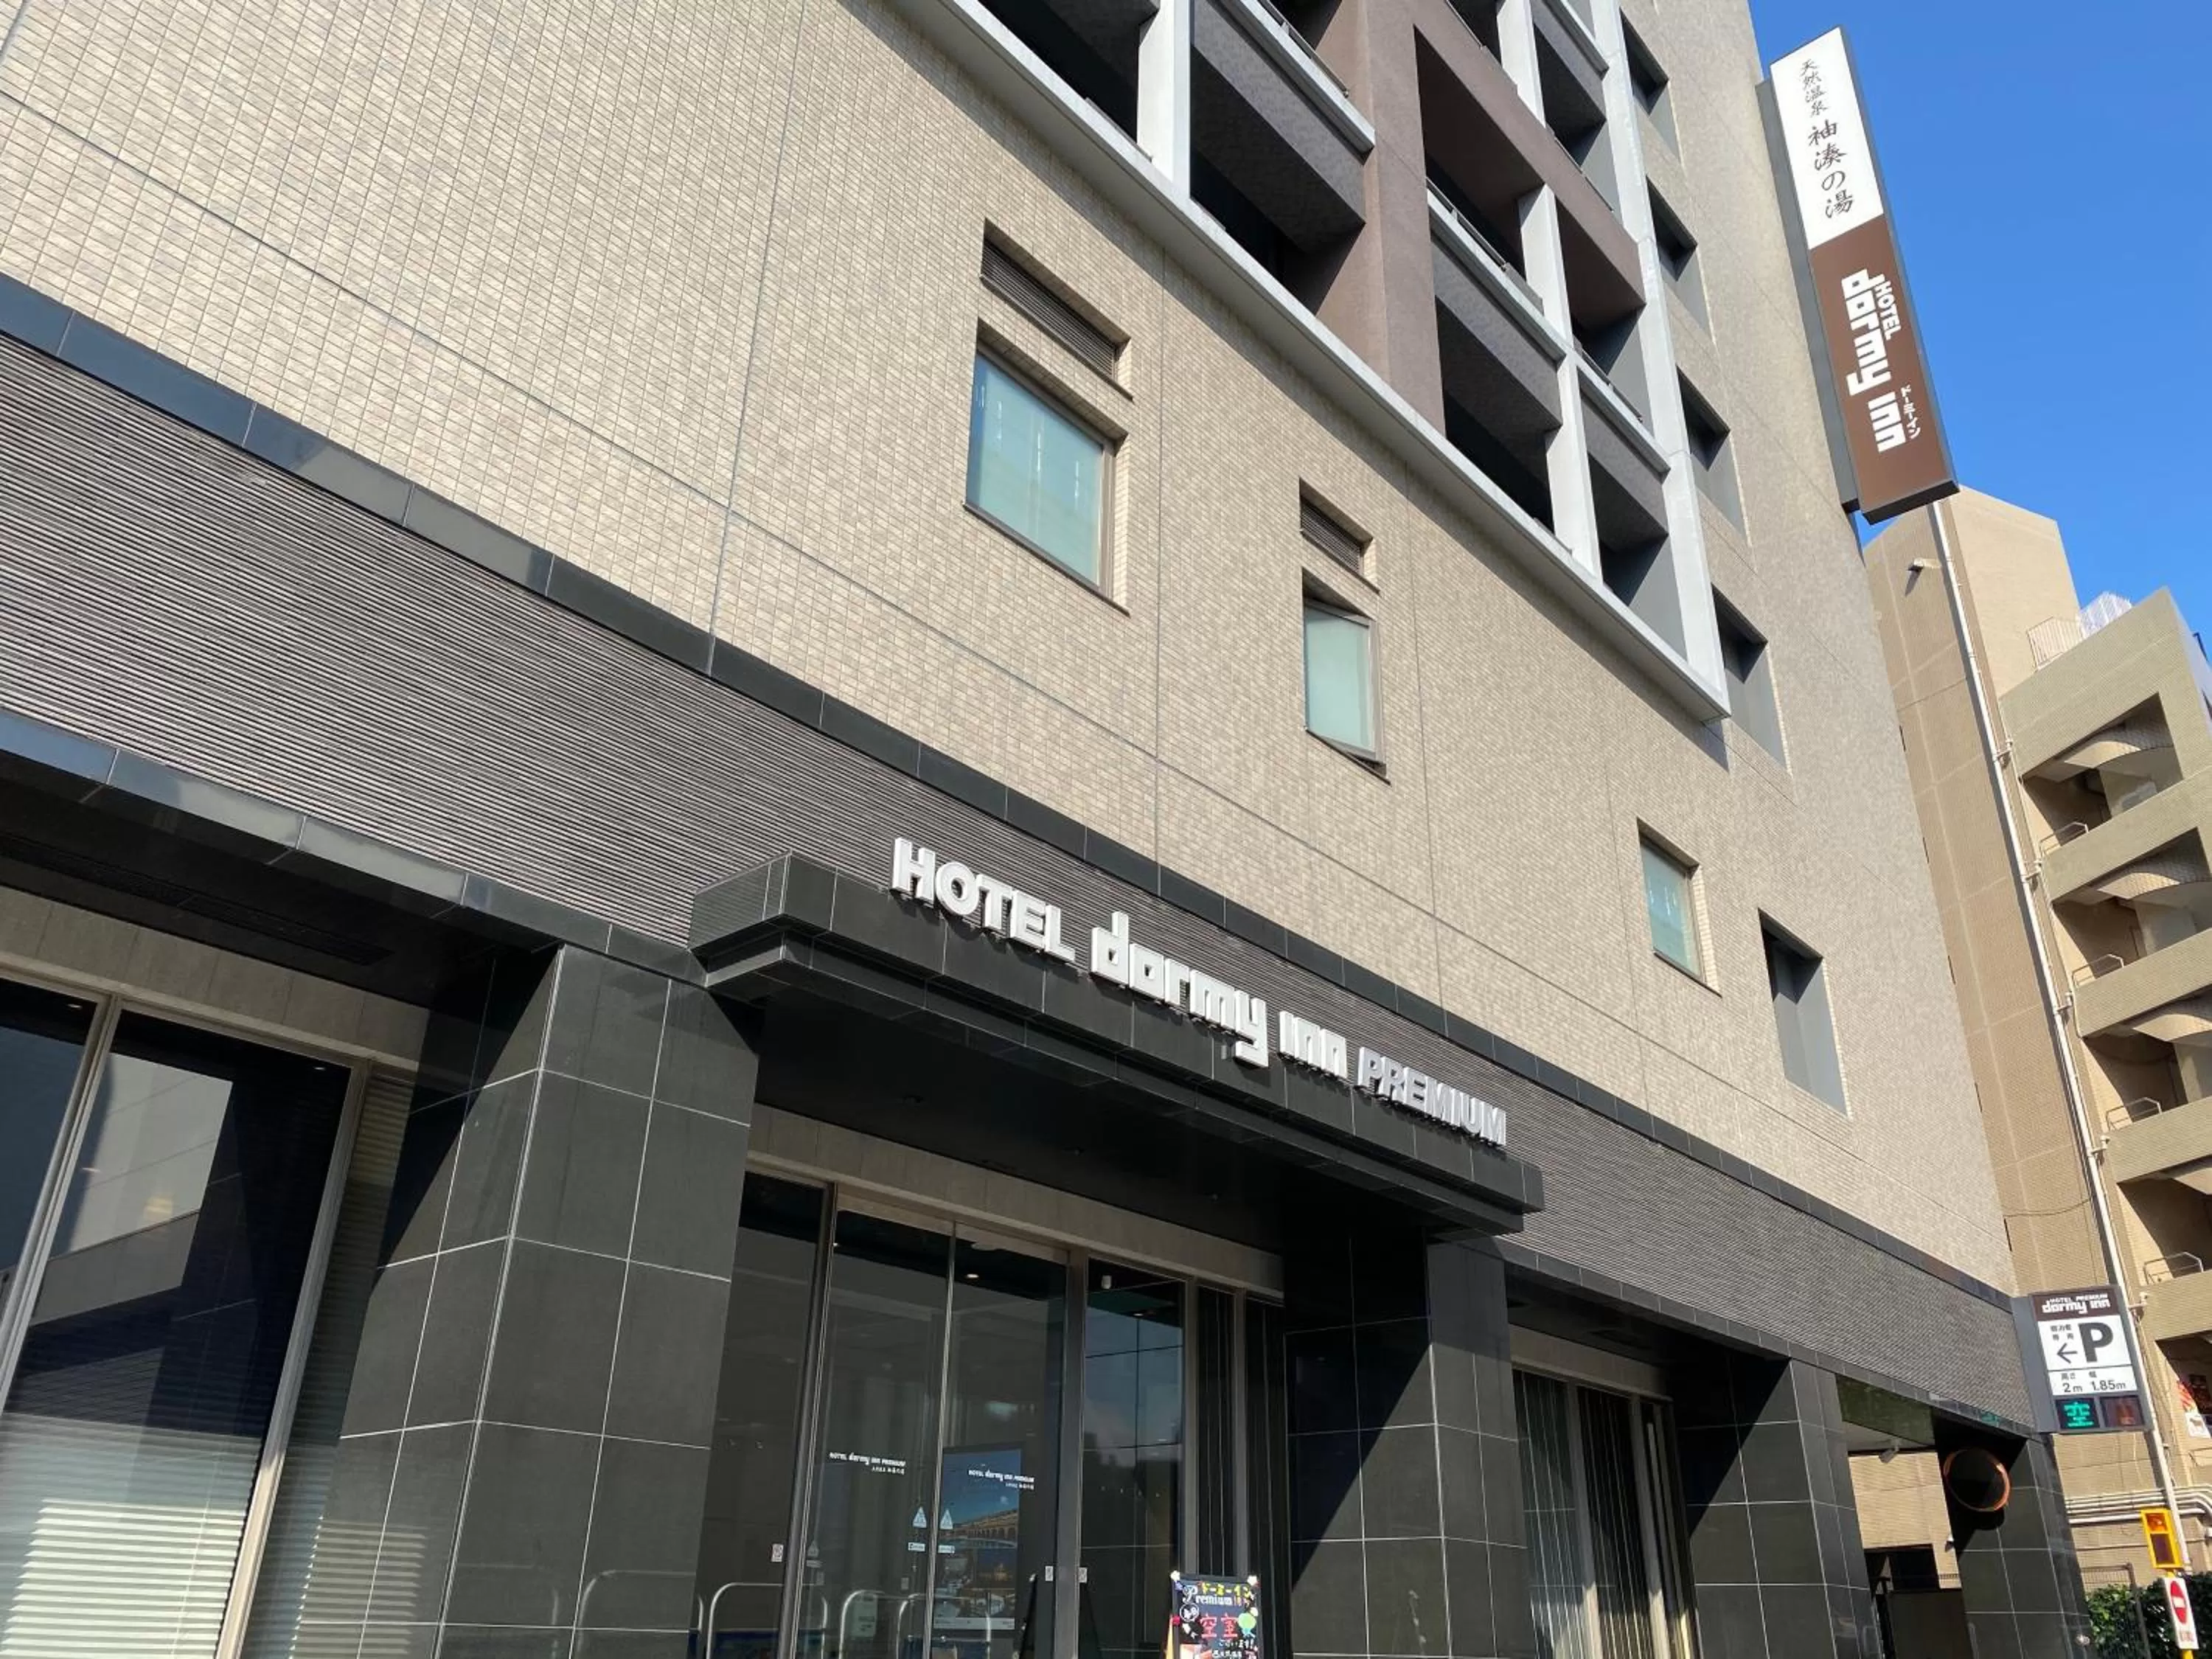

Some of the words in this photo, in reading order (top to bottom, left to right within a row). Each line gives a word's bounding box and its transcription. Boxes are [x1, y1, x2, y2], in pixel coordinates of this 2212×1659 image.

[1801, 58, 1829, 118] 天然温泉
[1808, 119, 1854, 218] 袖湊の湯
[1874, 281, 1902, 341] HOTEL
[1841, 268, 1892, 396] dormy
[1868, 392, 1906, 453] inn
[1900, 383, 1921, 439] ドーミーイン
[889, 837, 1076, 963] HOTEL
[1091, 911, 1268, 1068] dormy
[1279, 1010, 1348, 1079] inn
[1357, 1046, 1507, 1147] PREMIUM
[2042, 1300, 2088, 1315] dormy
[2089, 1298, 2111, 1309] inn
[2078, 1322, 2113, 1363] P
[2064, 1402, 2094, 1427] 空
[1200, 1613, 1239, 1638] 空室
